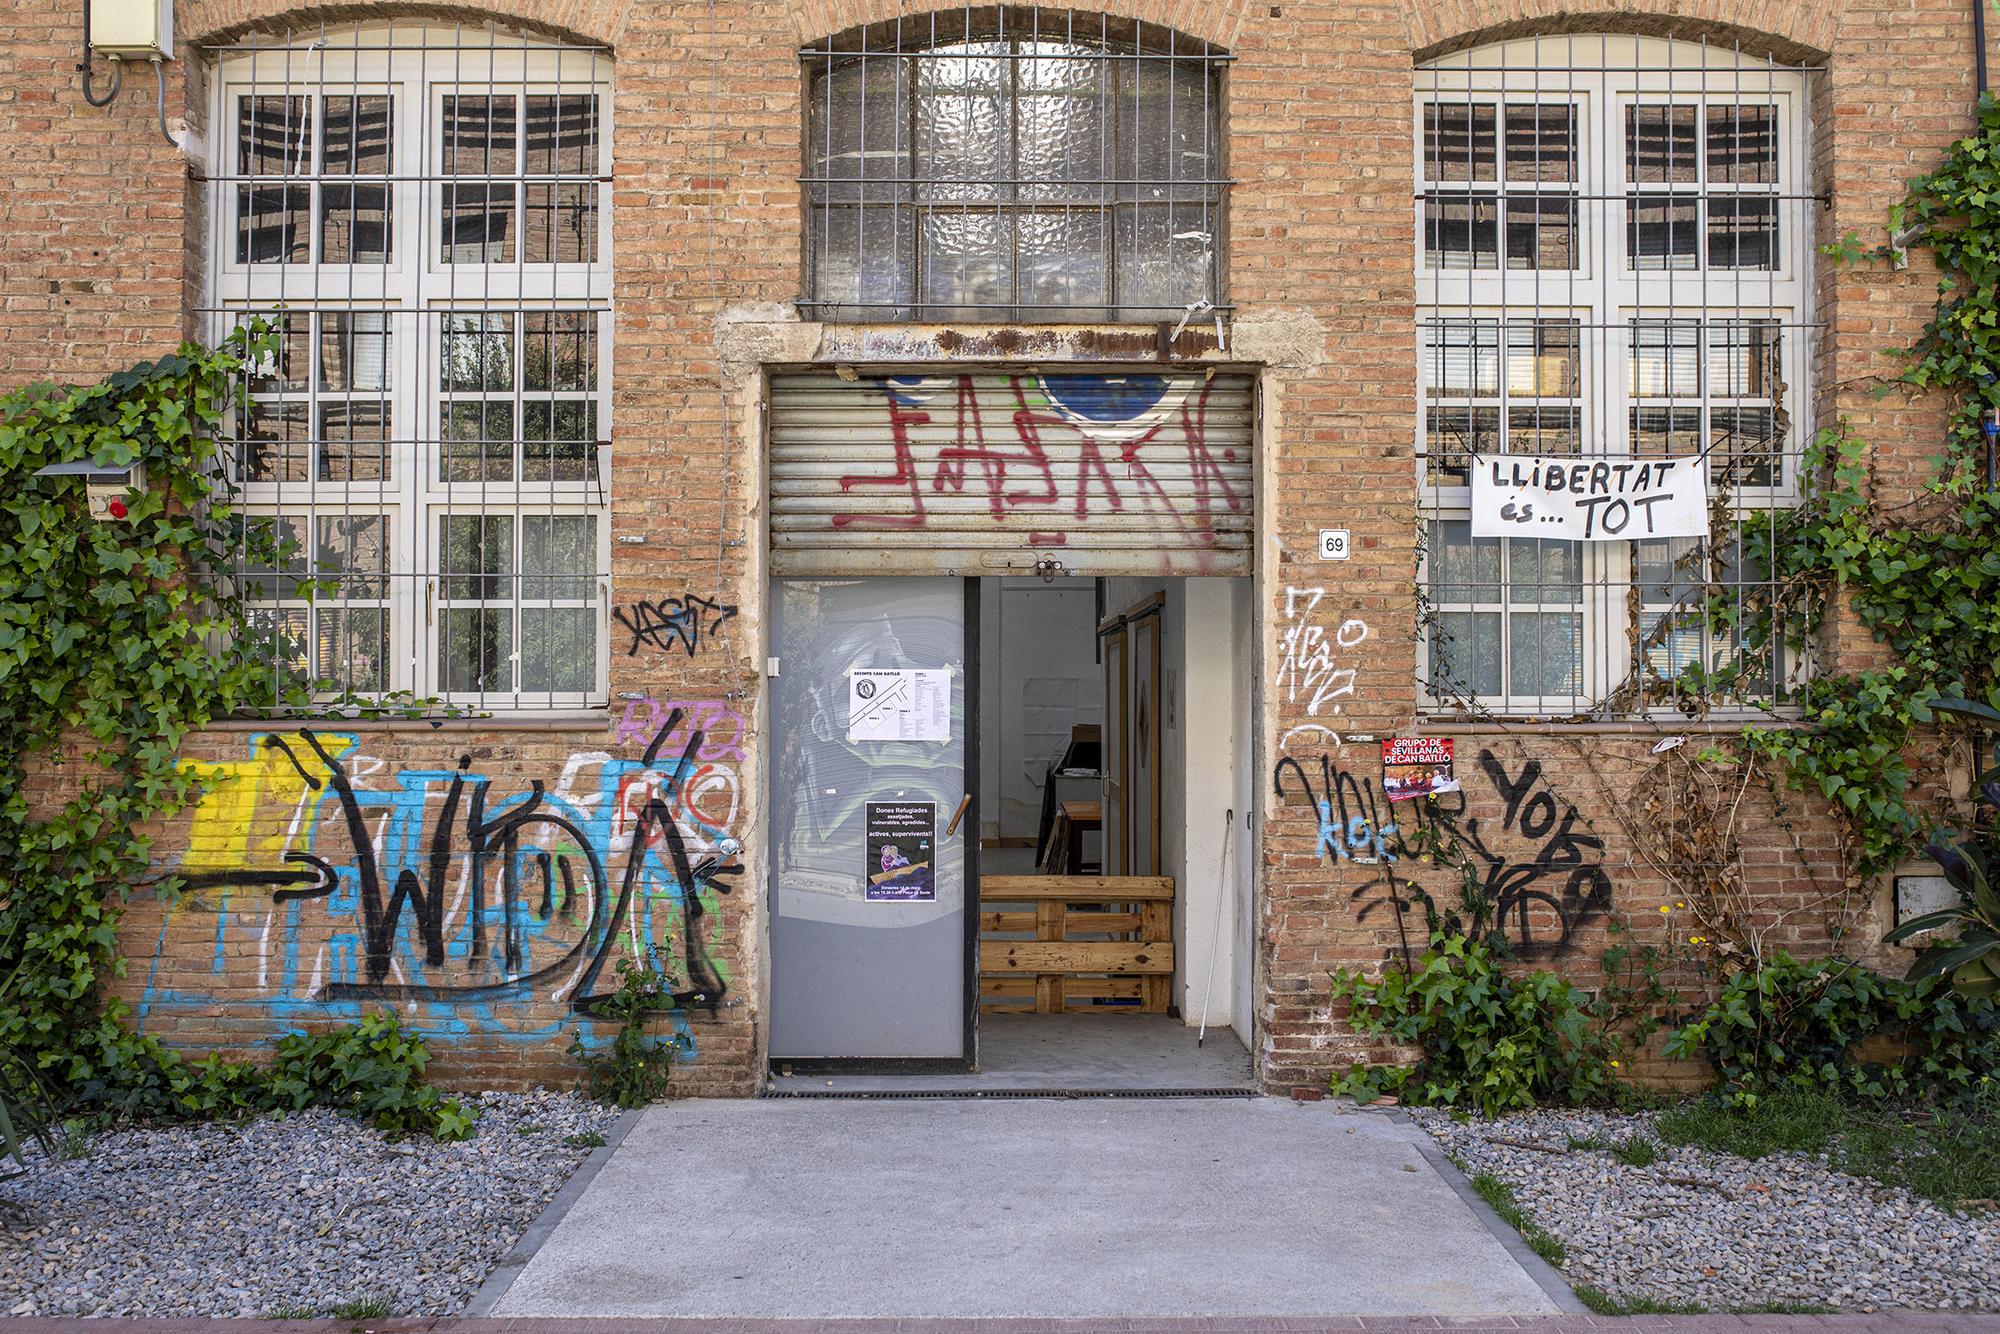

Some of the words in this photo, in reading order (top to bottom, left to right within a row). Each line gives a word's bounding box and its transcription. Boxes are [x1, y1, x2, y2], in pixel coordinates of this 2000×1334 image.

[1575, 493, 1674, 539] TOT
[1326, 537, 1343, 552] 69
[1394, 739, 1427, 747] GRUPO
[1430, 738, 1442, 746] DE
[1391, 746, 1444, 755] SEVILLANAS
[1385, 755, 1396, 764] DE
[1397, 755, 1418, 763] CAN
[1419, 752, 1451, 763] BATLLÓ
